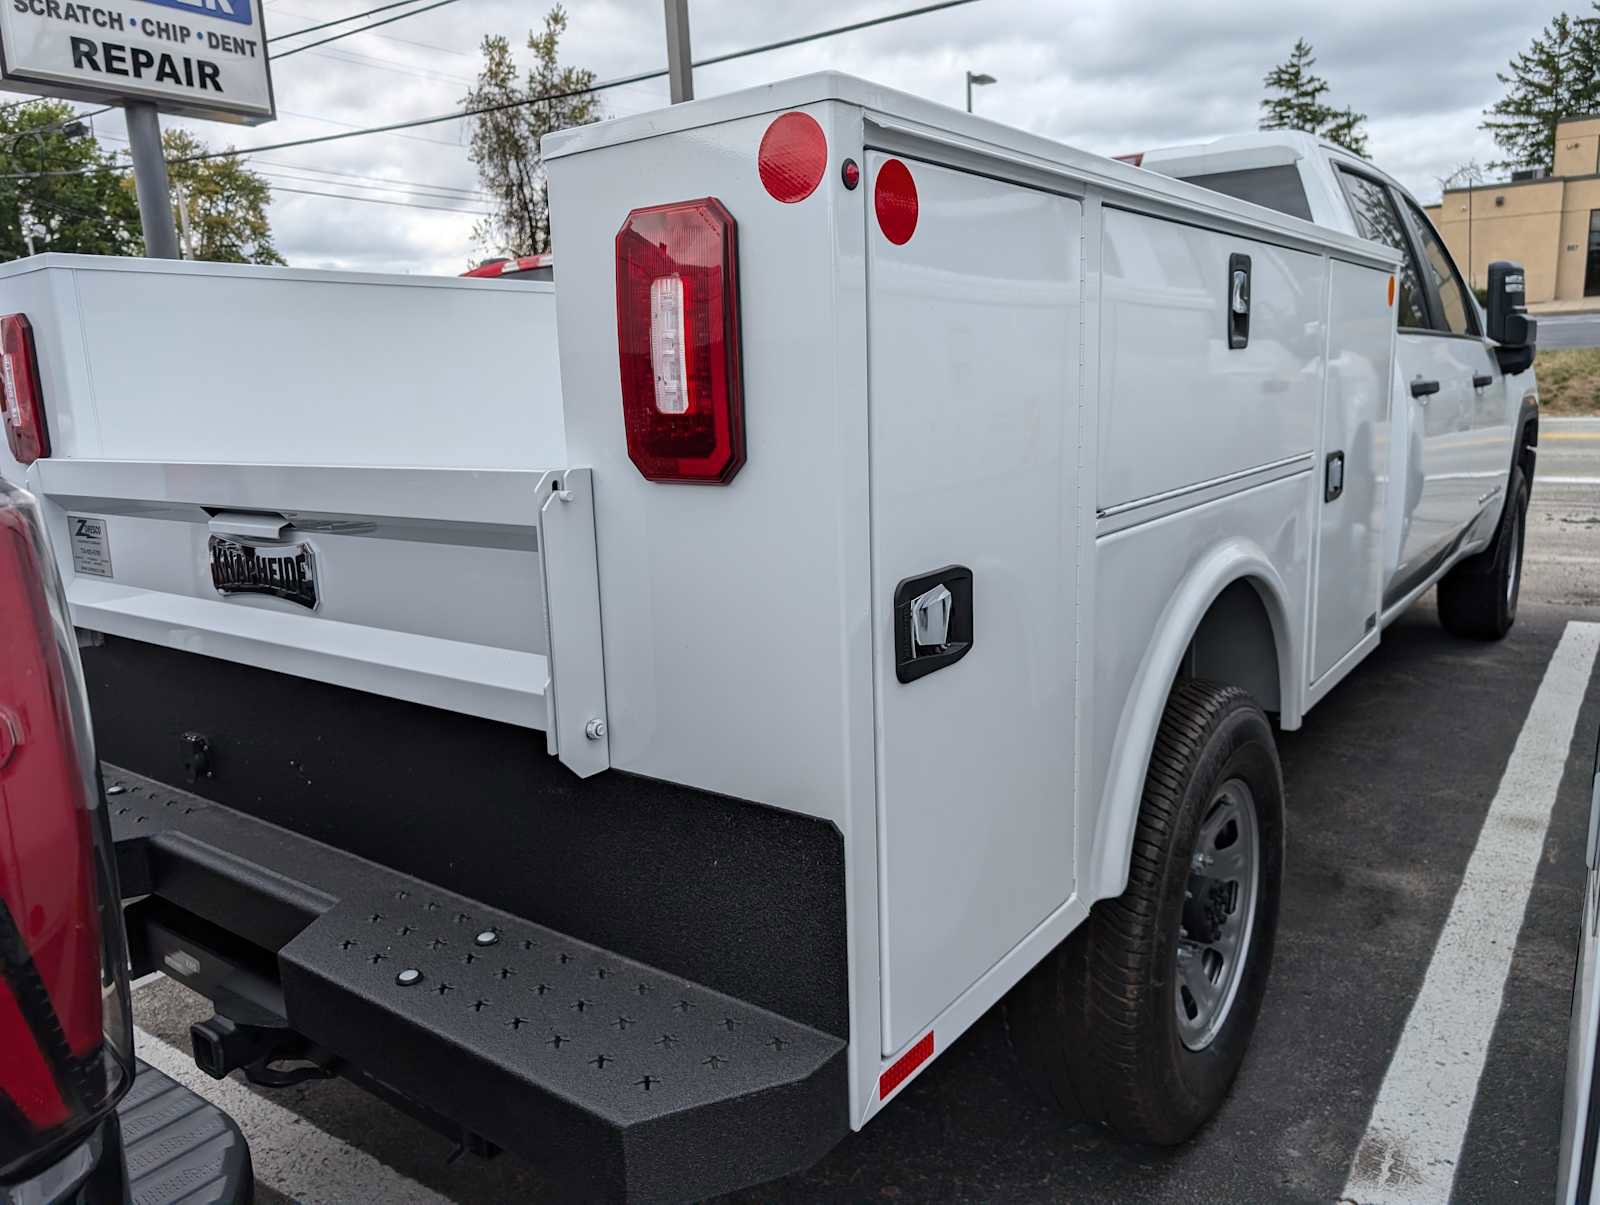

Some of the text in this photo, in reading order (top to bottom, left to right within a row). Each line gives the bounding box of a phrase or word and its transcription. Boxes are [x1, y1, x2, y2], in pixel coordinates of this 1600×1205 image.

[14, 0, 257, 57] SCRATCH CHIP DENT
[70, 36, 224, 92] REPAIR
